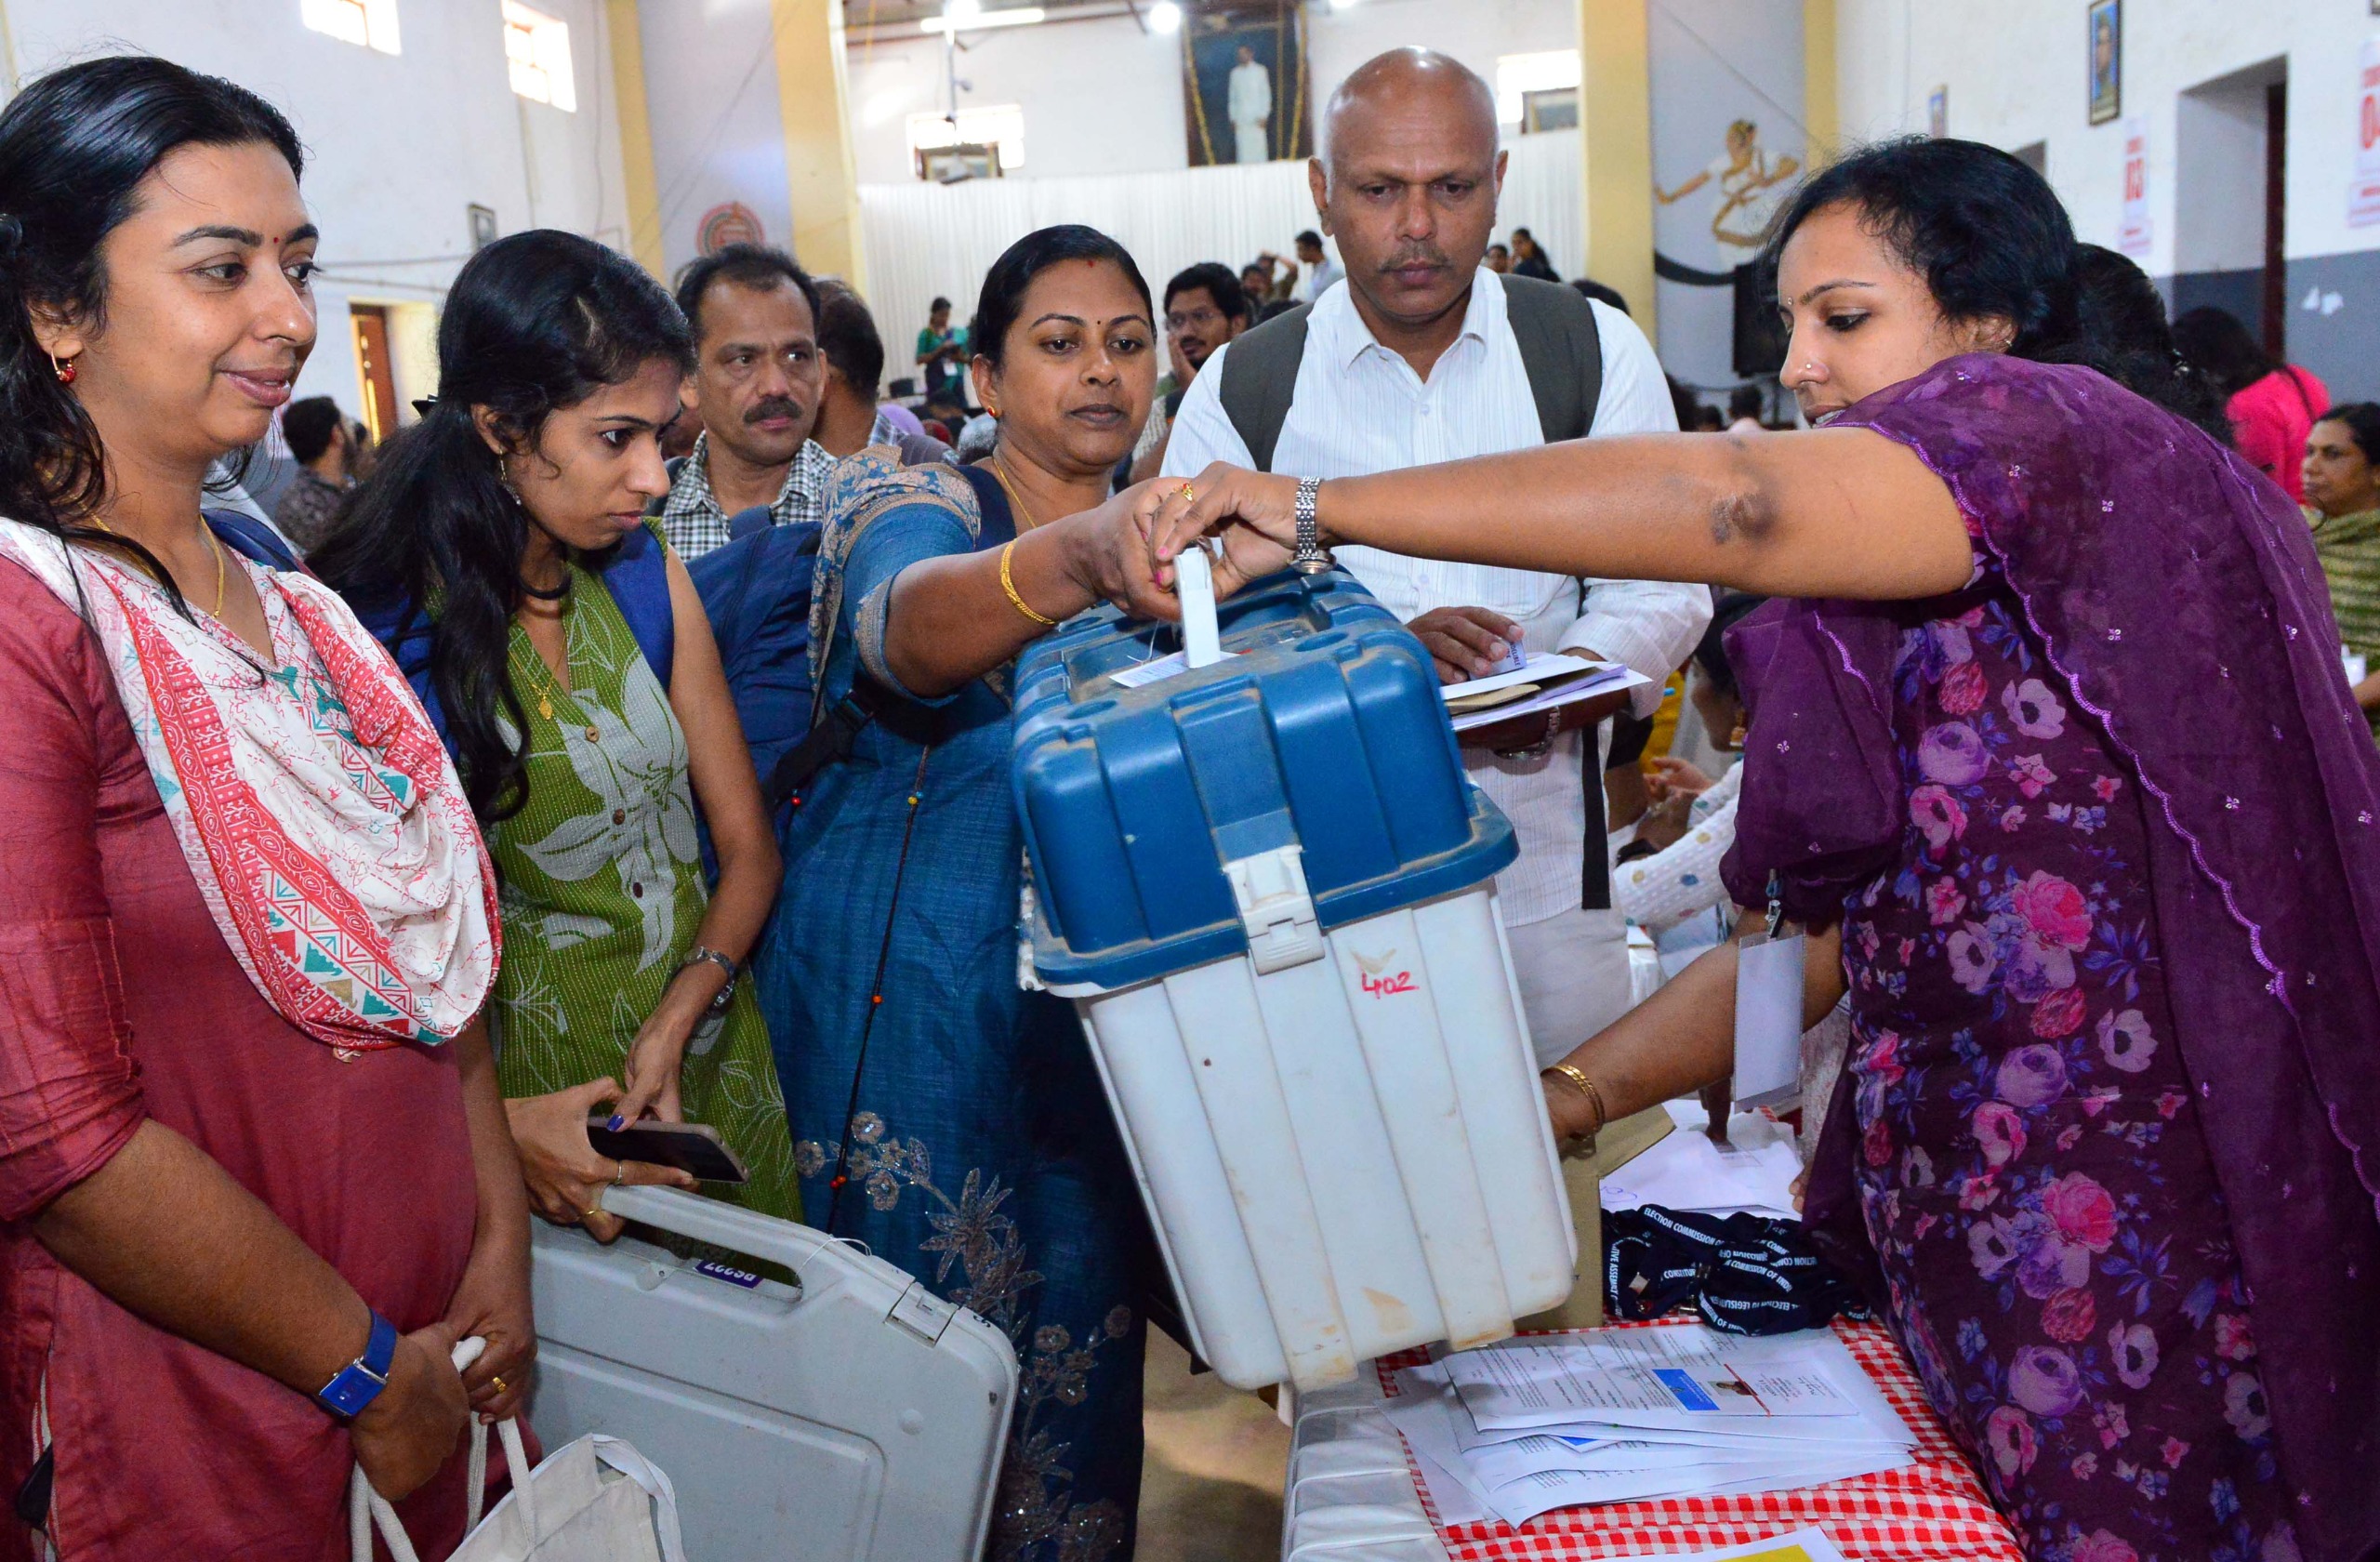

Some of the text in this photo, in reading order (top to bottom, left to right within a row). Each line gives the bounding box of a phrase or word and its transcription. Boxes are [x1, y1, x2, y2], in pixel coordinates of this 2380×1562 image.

[1361, 970, 1420, 999] 402
[1644, 1207, 1673, 1229] ELECTION
[1673, 1223, 1716, 1246] COMMISSION
[1608, 1263, 1620, 1295] ASSEMBLY
[1766, 1270, 1778, 1281] OF
[1717, 1317, 1728, 1329] OF
